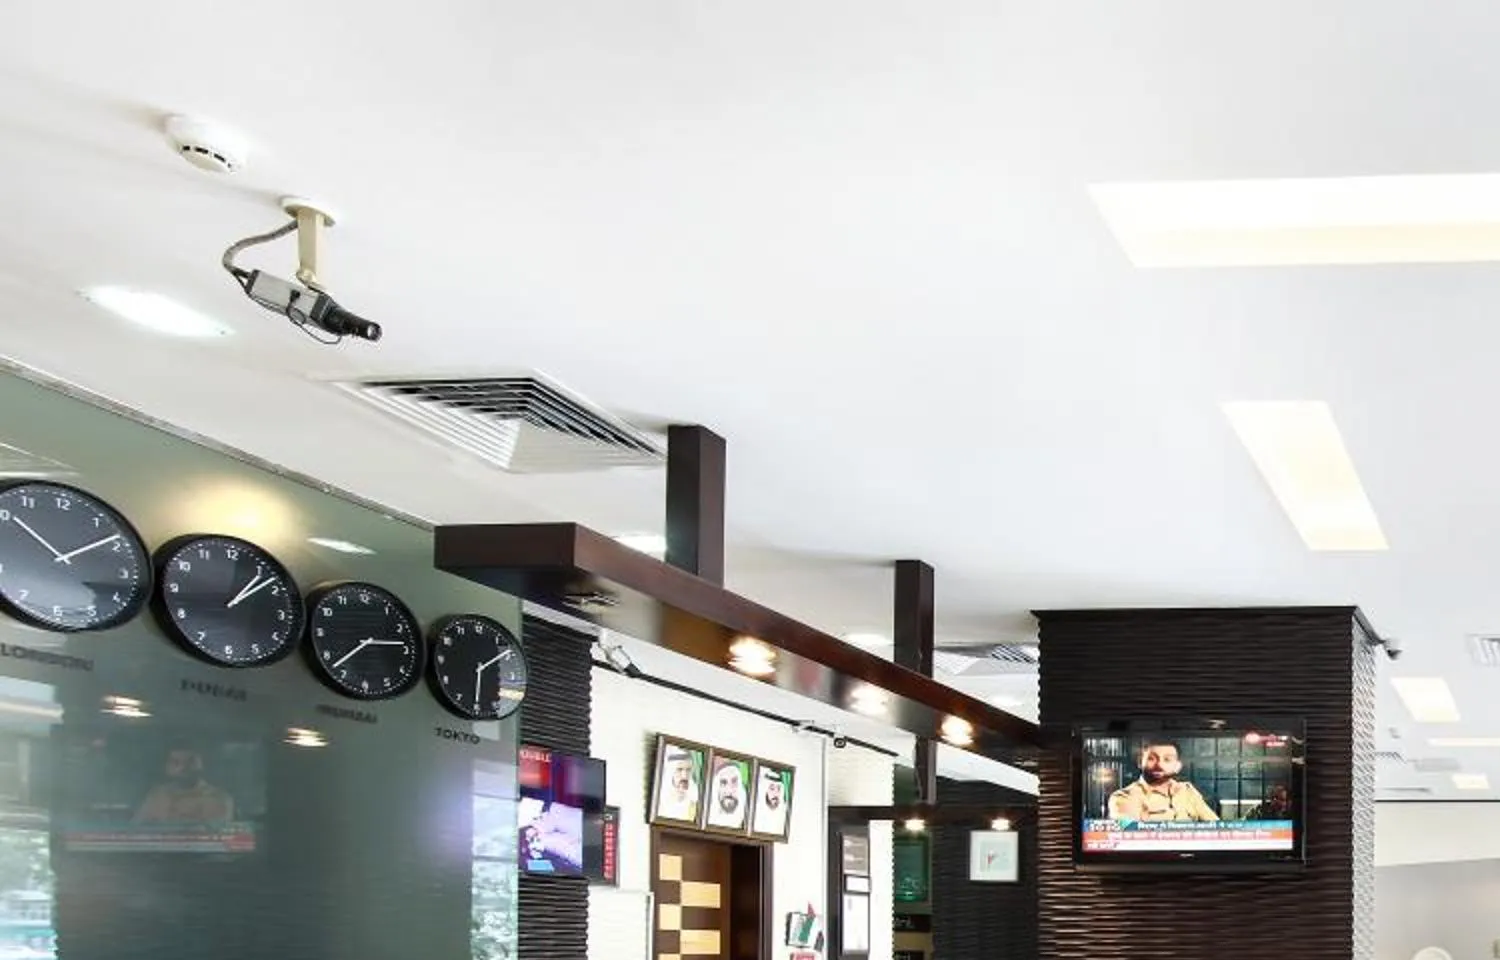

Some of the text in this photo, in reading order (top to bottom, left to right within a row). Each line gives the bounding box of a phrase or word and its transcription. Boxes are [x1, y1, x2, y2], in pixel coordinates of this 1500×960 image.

[22, 496, 35, 508] 11
[56, 498, 71, 510] 12
[93, 517, 100, 528] 1
[112, 542, 121, 552] 2
[199, 549, 209, 560] 11
[226, 549, 239, 561] 12
[179, 561, 191, 572] 10
[271, 586, 279, 596] 2
[87, 605, 97, 616] 5
[178, 608, 185, 619] 8
[278, 610, 285, 620] 3
[322, 608, 333, 616] 10
[251, 644, 259, 654] 5
[434, 727, 480, 744] TOKYO
